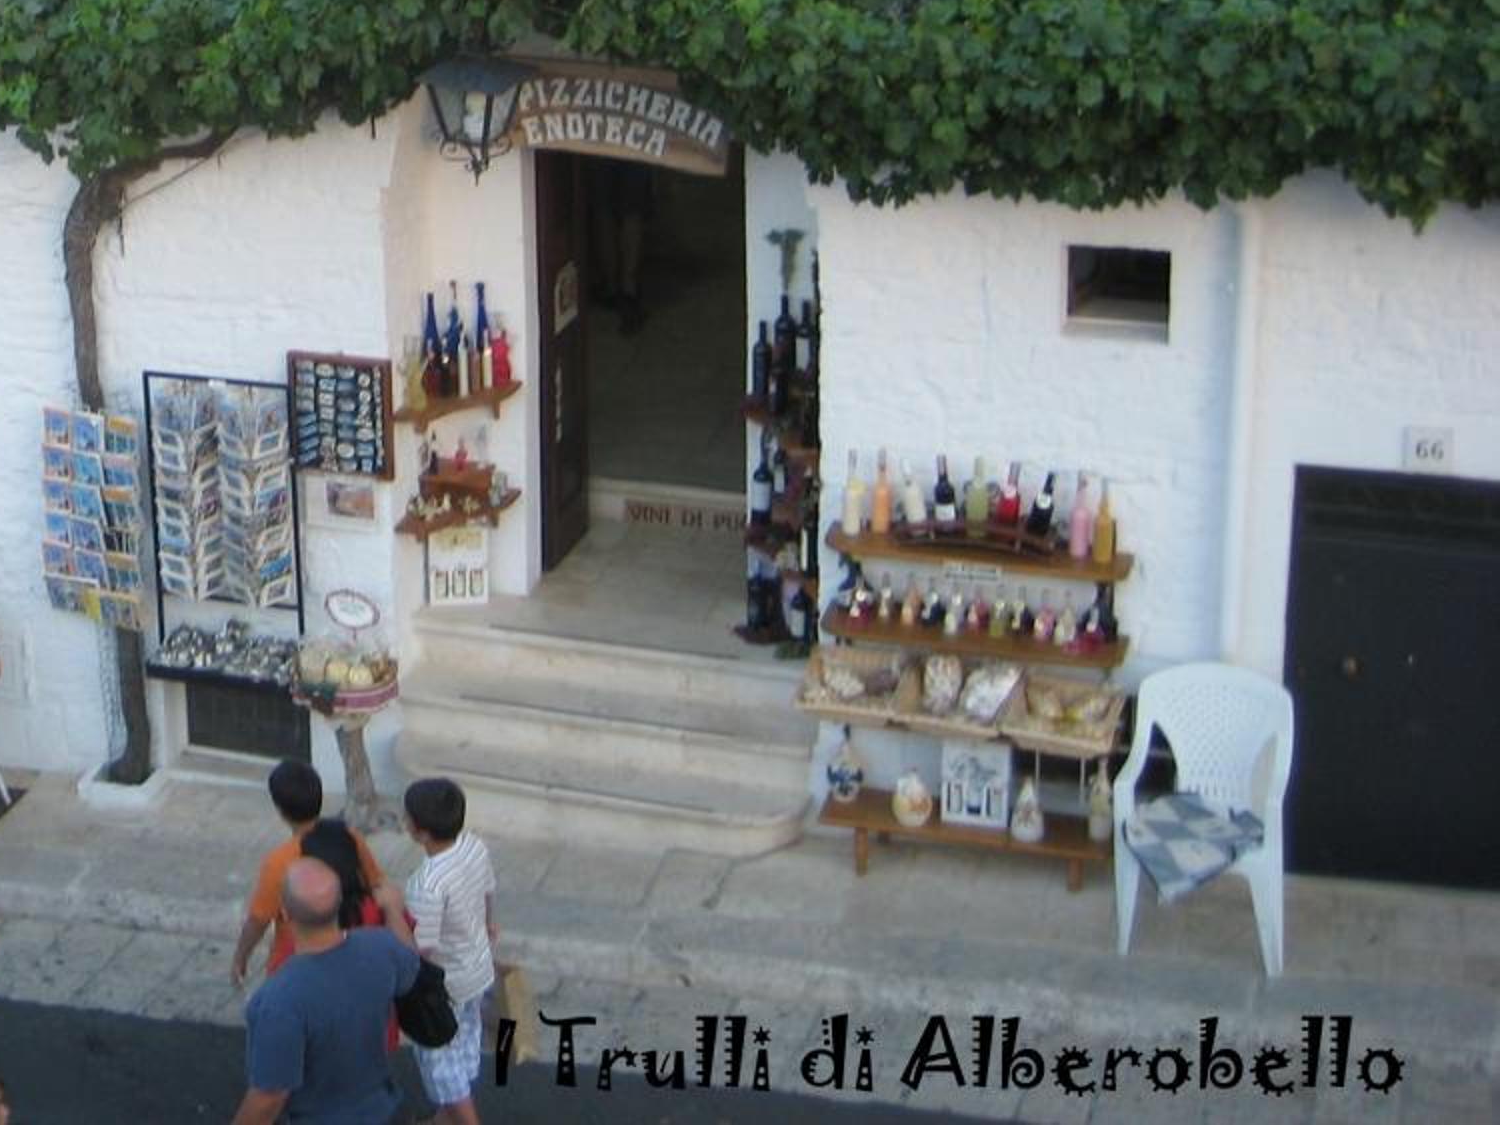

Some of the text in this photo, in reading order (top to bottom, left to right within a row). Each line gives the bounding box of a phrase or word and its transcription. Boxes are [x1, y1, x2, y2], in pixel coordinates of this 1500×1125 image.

[518, 77, 725, 148] PIZZICHERIA
[521, 111, 667, 157] ENOTECA
[1415, 438, 1445, 461] 66
